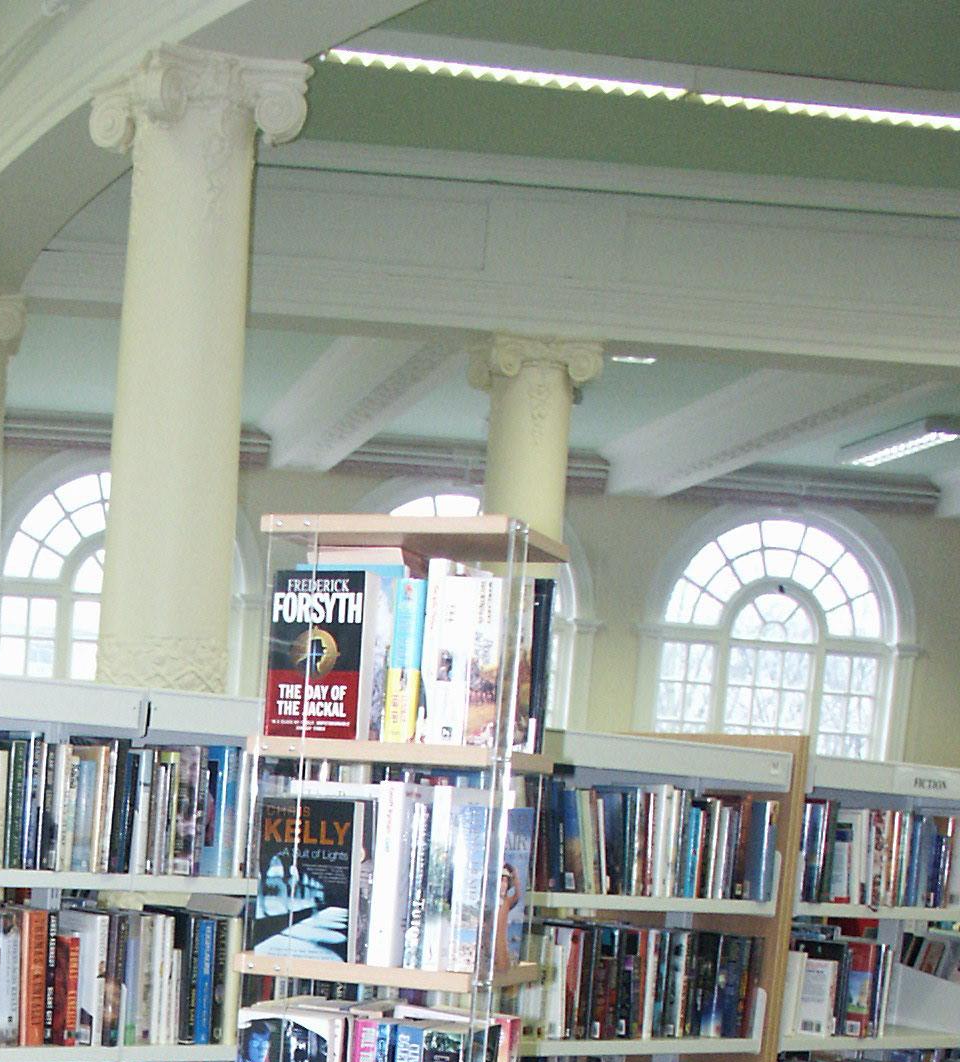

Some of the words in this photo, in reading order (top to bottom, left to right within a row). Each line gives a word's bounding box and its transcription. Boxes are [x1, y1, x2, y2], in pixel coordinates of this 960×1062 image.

[287, 578, 350, 593] FREDERICK
[272, 592, 363, 624] FORSYTH
[278, 683, 302, 699] THE
[304, 685, 329, 700] DAY
[329, 685, 347, 701] OF
[276, 699, 300, 716] THE
[302, 700, 347, 718] JACKAL
[913, 777, 947, 789] FICTION
[263, 817, 352, 846] KELLY
[312, 848, 322, 858] of
[69, 946, 79, 979] THOMAS
